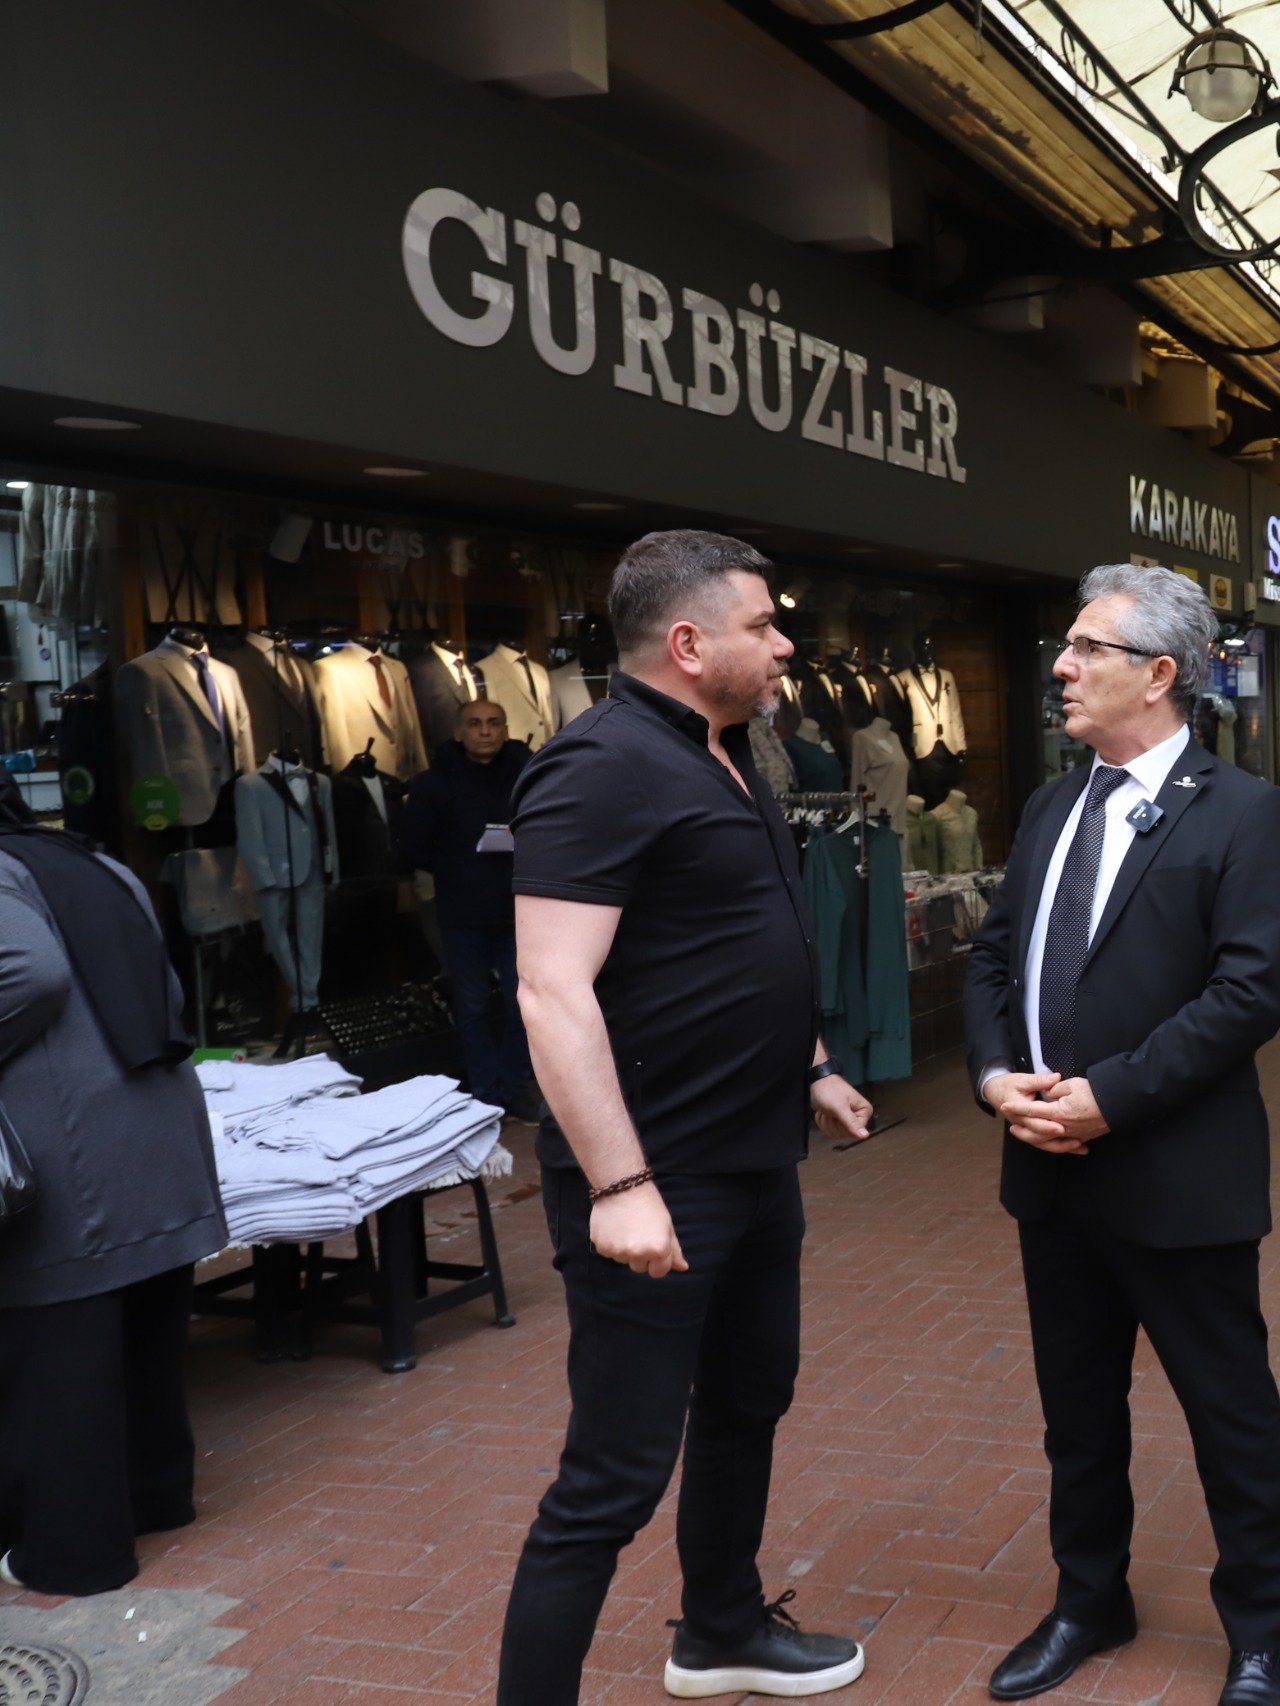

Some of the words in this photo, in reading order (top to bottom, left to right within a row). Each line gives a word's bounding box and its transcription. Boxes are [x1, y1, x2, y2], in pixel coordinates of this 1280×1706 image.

[401, 186, 967, 484] GÜRBÜZLER
[322, 521, 425, 559] LUCAS
[1129, 474, 1241, 563] KARAKAYA
